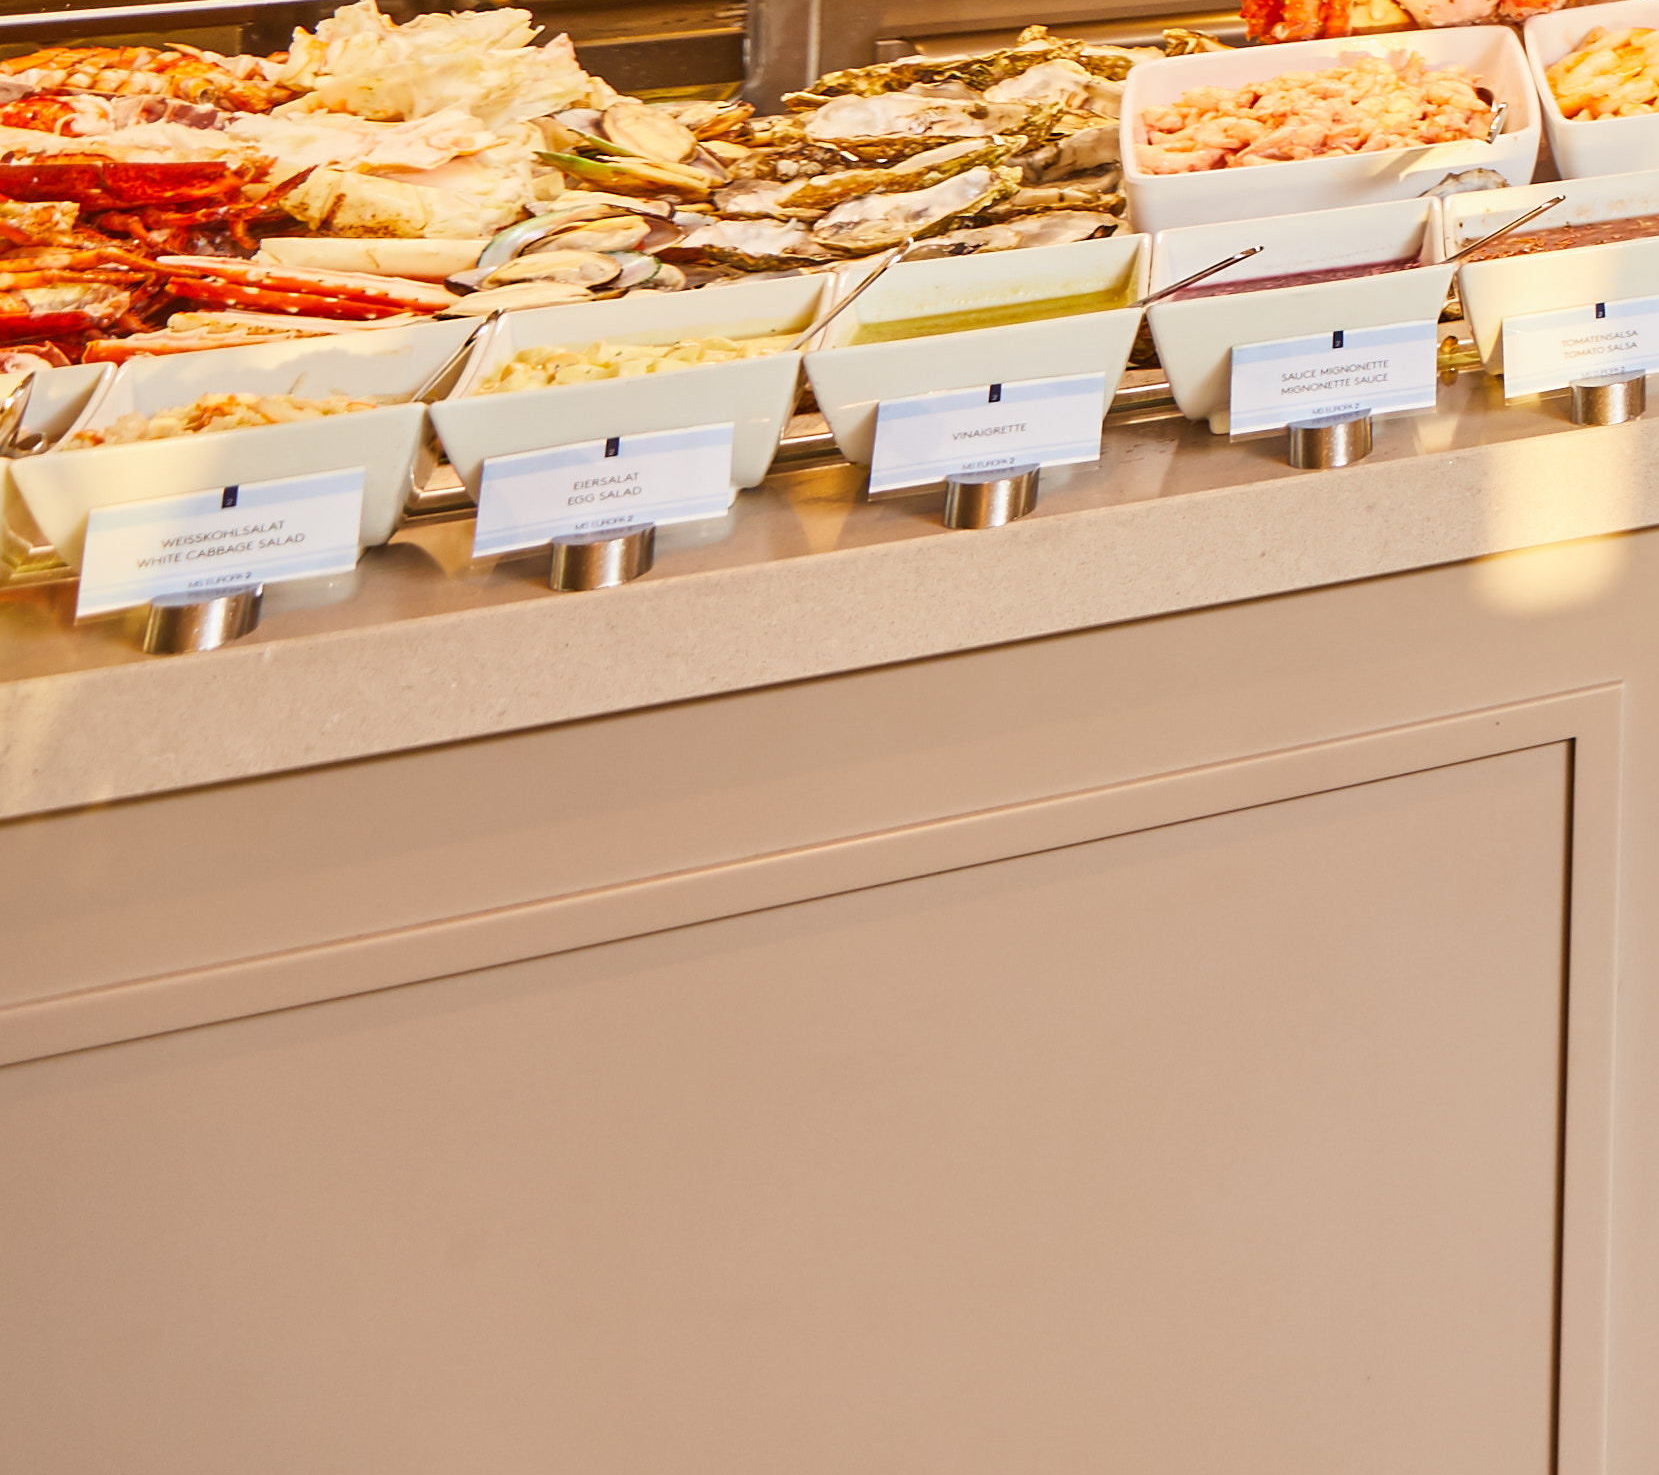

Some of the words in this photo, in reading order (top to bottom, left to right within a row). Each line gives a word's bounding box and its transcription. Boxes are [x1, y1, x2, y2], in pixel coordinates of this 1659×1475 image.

[1562, 329, 1638, 348] TOMATENSALSA
[1564, 347, 1604, 360] TOMATO
[1607, 341, 1638, 353] SALSA
[1281, 369, 1317, 382] SAUCE
[1320, 359, 1389, 377] MIGNONETTE
[1281, 378, 1350, 395] MIGNONETTE
[1354, 373, 1389, 386] SAUCE
[952, 422, 1027, 441] VINAIGRETTE
[573, 472, 640, 491] EIERSALAT
[567, 493, 594, 506] EGG
[599, 486, 642, 501] SALAD
[162, 520, 285, 548] WEISSKOHLSALAT
[137, 552, 180, 569] WHITE
[186, 541, 253, 560] CABBAGE
[259, 532, 305, 549] SALAD
